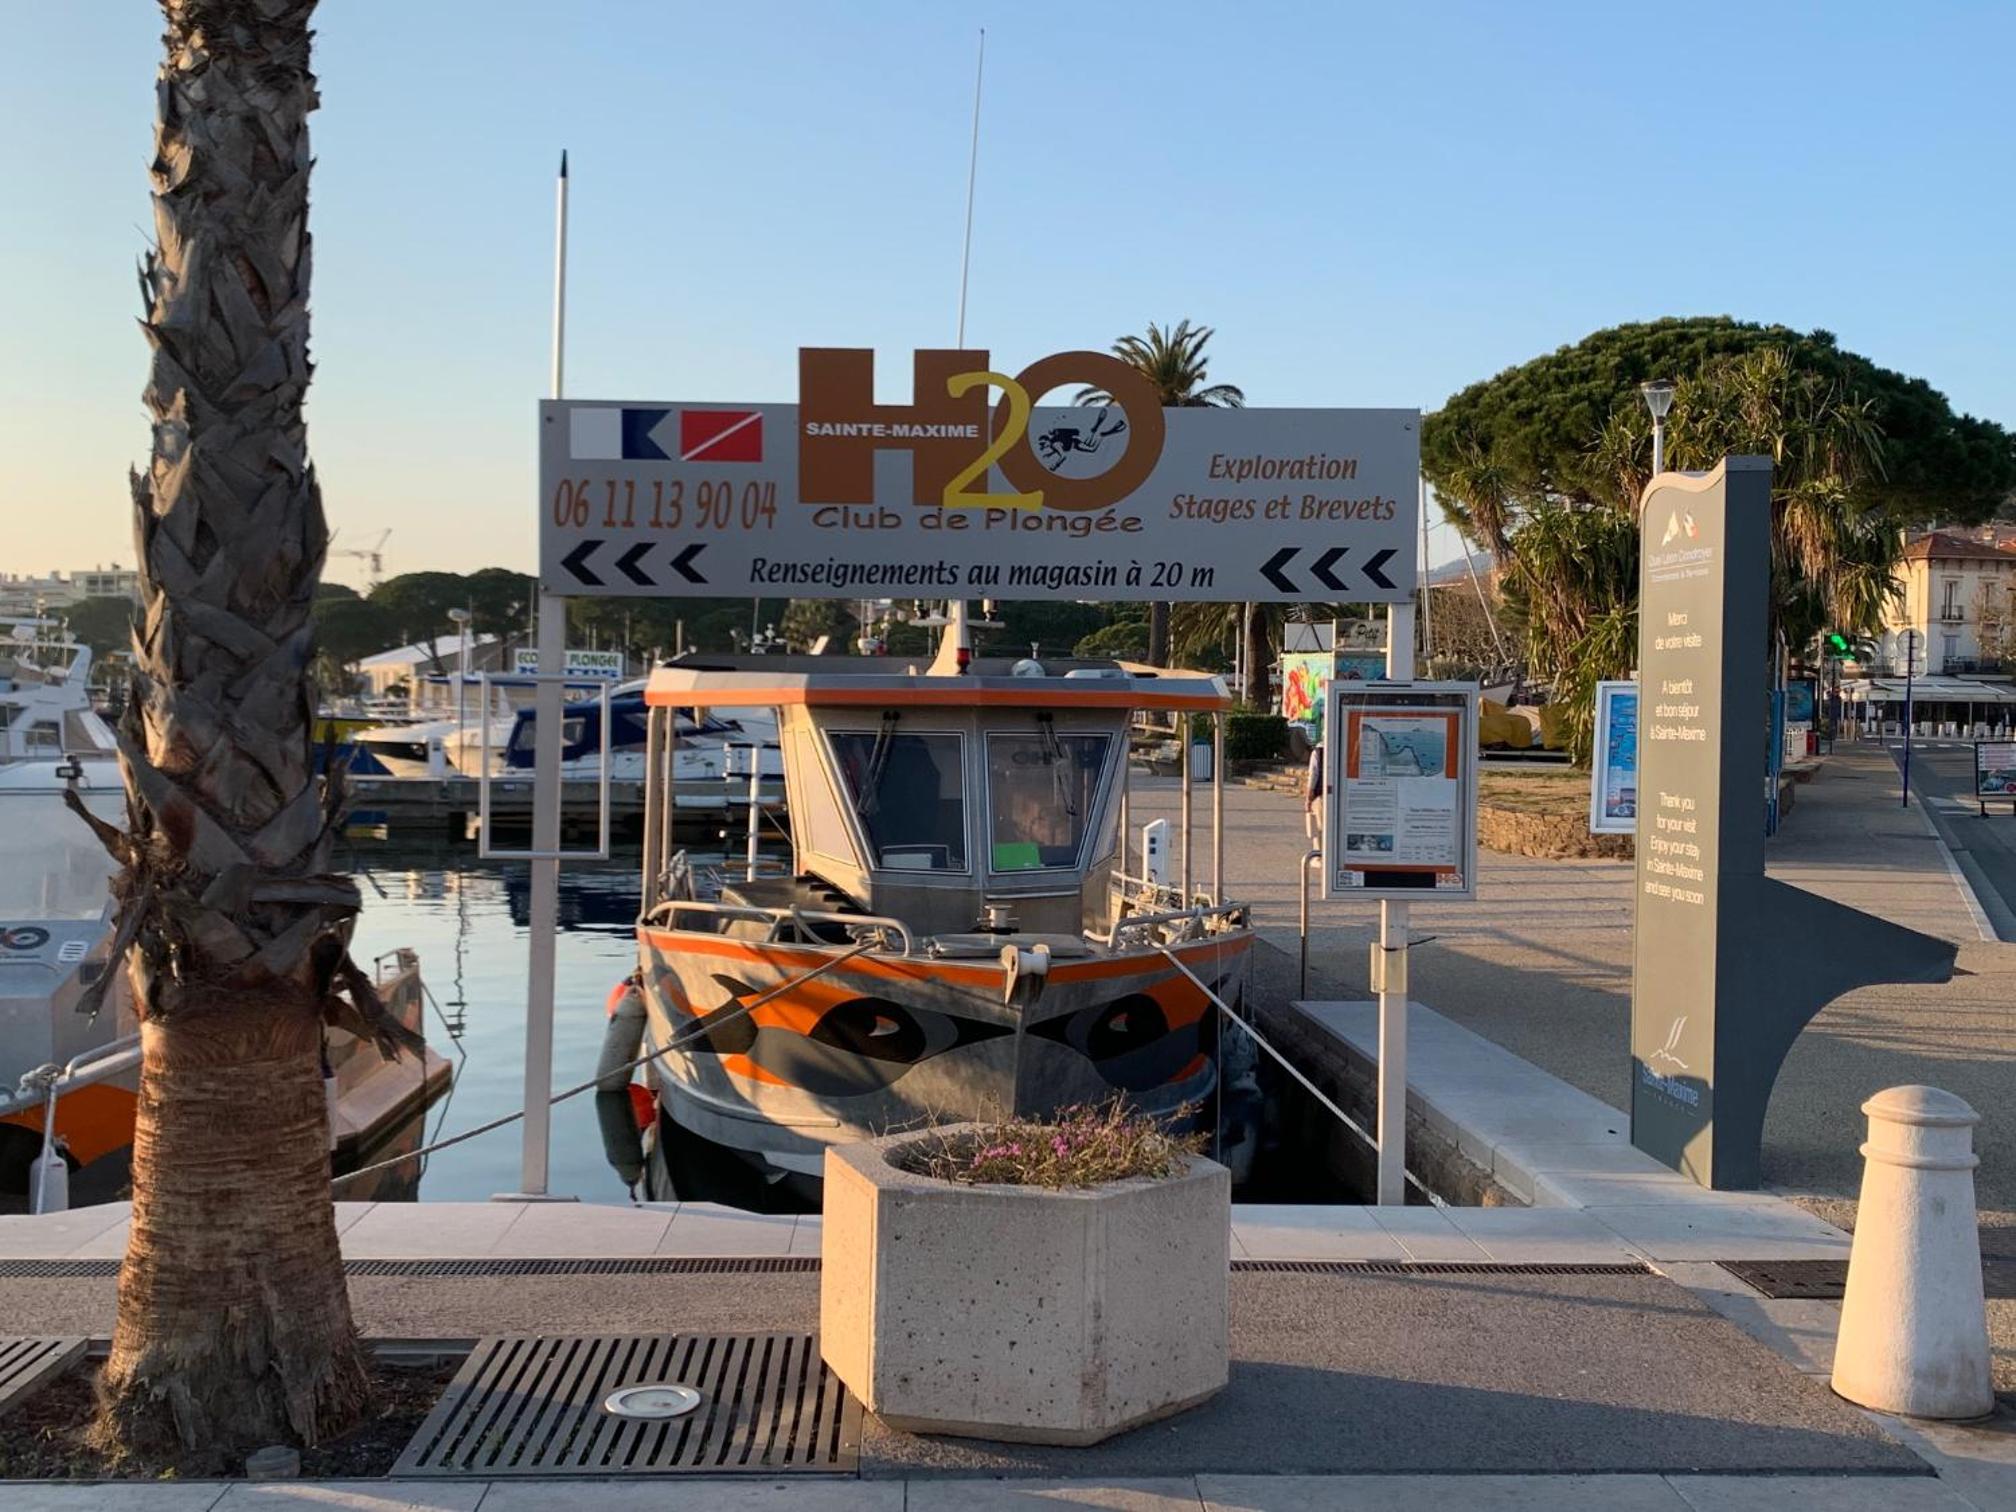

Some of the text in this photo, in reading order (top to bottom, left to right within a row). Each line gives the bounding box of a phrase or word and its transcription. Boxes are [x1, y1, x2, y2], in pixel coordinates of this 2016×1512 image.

[799, 347, 1165, 512] H2O
[805, 421, 979, 438] SAINTE-MAXIME
[1208, 453, 1358, 483] Exploration
[554, 479, 777, 529] 06 11 13 90 04
[1169, 494, 1397, 524] Stages et Brevets
[812, 506, 1145, 537] Club de Plongée
[750, 557, 1214, 590] Renseignements au magasin à 20 m
[1668, 611, 1688, 626] Merci
[1656, 725, 1706, 741] Sainte-Maxime
[1659, 791, 1696, 812] Thank you
[1654, 858, 1704, 882] Sainte-Maxime
